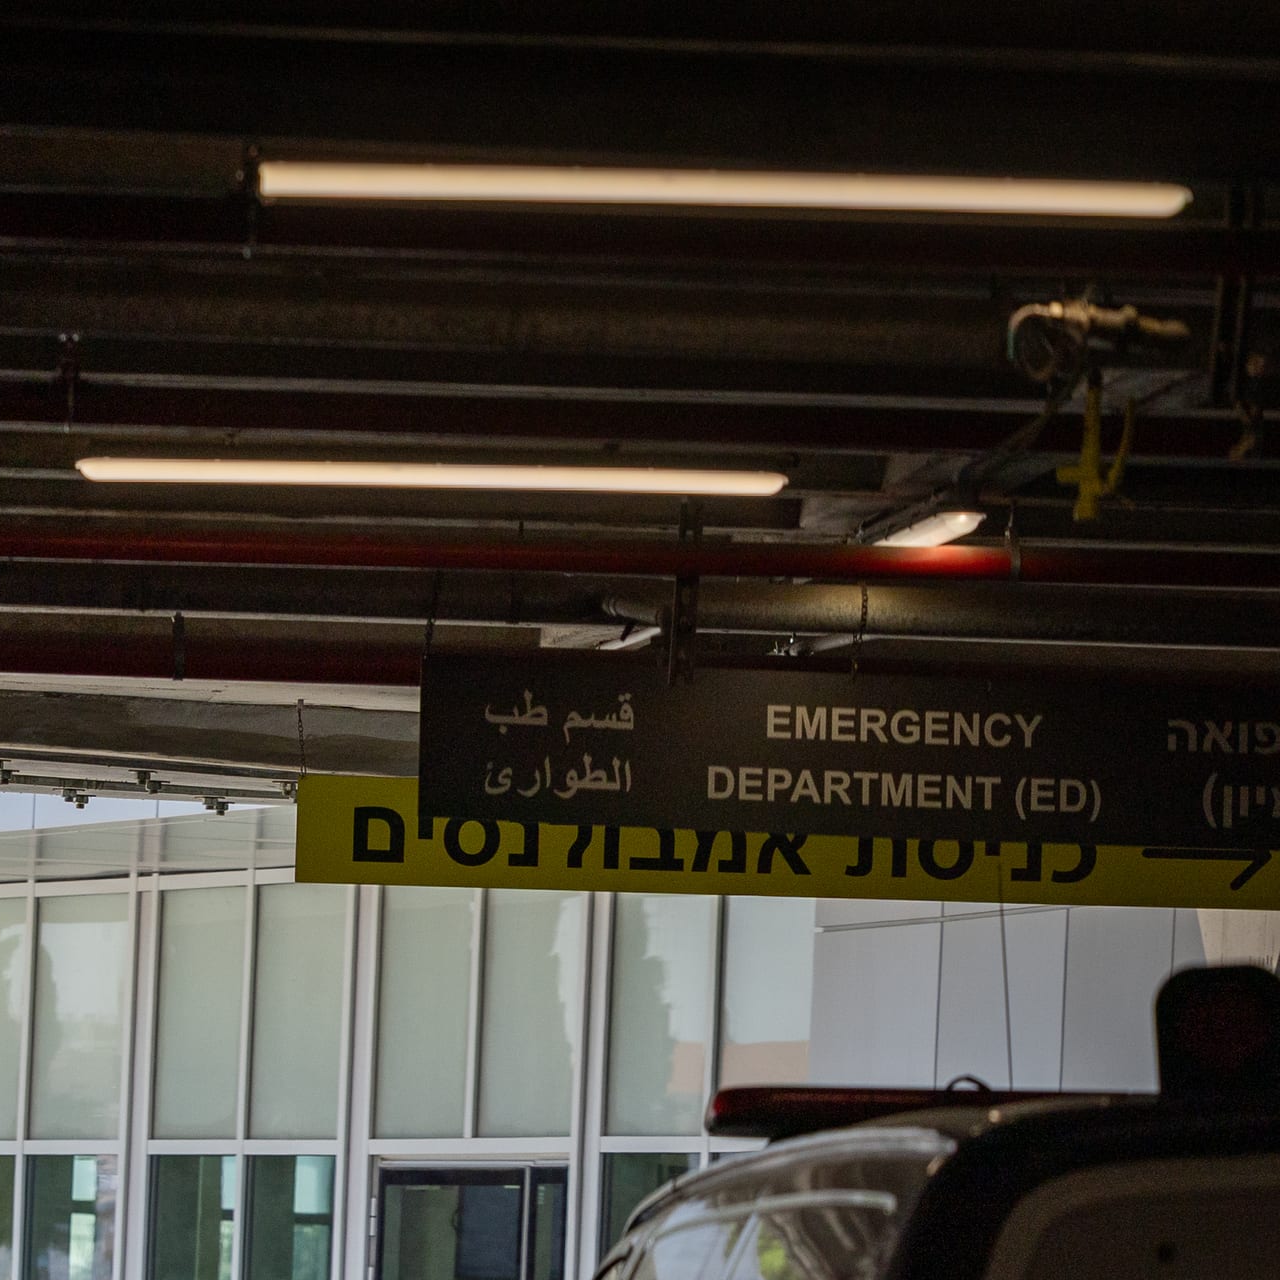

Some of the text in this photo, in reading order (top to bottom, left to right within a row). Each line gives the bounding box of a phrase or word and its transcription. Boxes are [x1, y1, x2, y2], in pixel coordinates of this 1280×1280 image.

[484, 688, 636, 745] قسم طب
[767, 703, 1043, 749] EMERGENCY
[484, 751, 632, 800] الطوارئ
[707, 764, 1103, 823] DEPARTMENT (ED)
